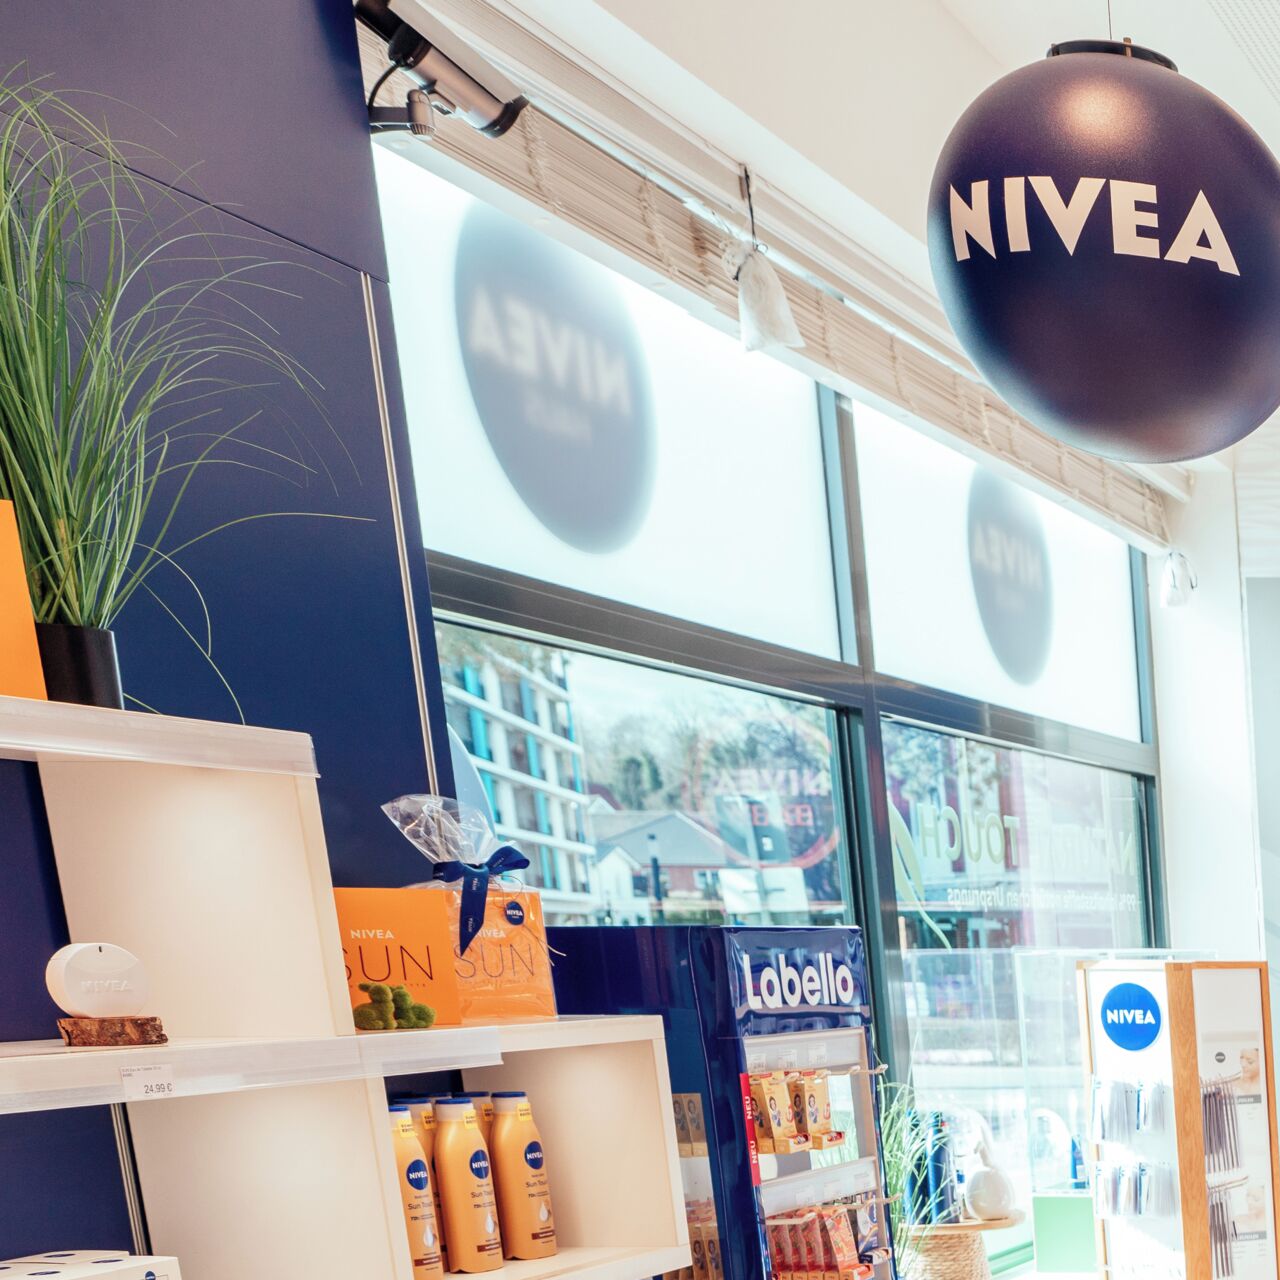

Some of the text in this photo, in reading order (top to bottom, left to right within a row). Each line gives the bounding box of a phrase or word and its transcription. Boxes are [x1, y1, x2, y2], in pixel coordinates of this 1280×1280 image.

[950, 176, 1240, 276] NIVEA
[506, 908, 524, 917] NIVEA
[351, 929, 394, 939] NIVEA
[455, 944, 534, 978] SUN
[743, 952, 854, 1009] Labello
[1106, 1008, 1156, 1028] NIVEA
[745, 1095, 753, 1121] NEU
[527, 1152, 543, 1160] NIVEA
[751, 1139, 759, 1165] NEU
[472, 1161, 489, 1169] NIVEA
[409, 1171, 428, 1180] NIVEA
